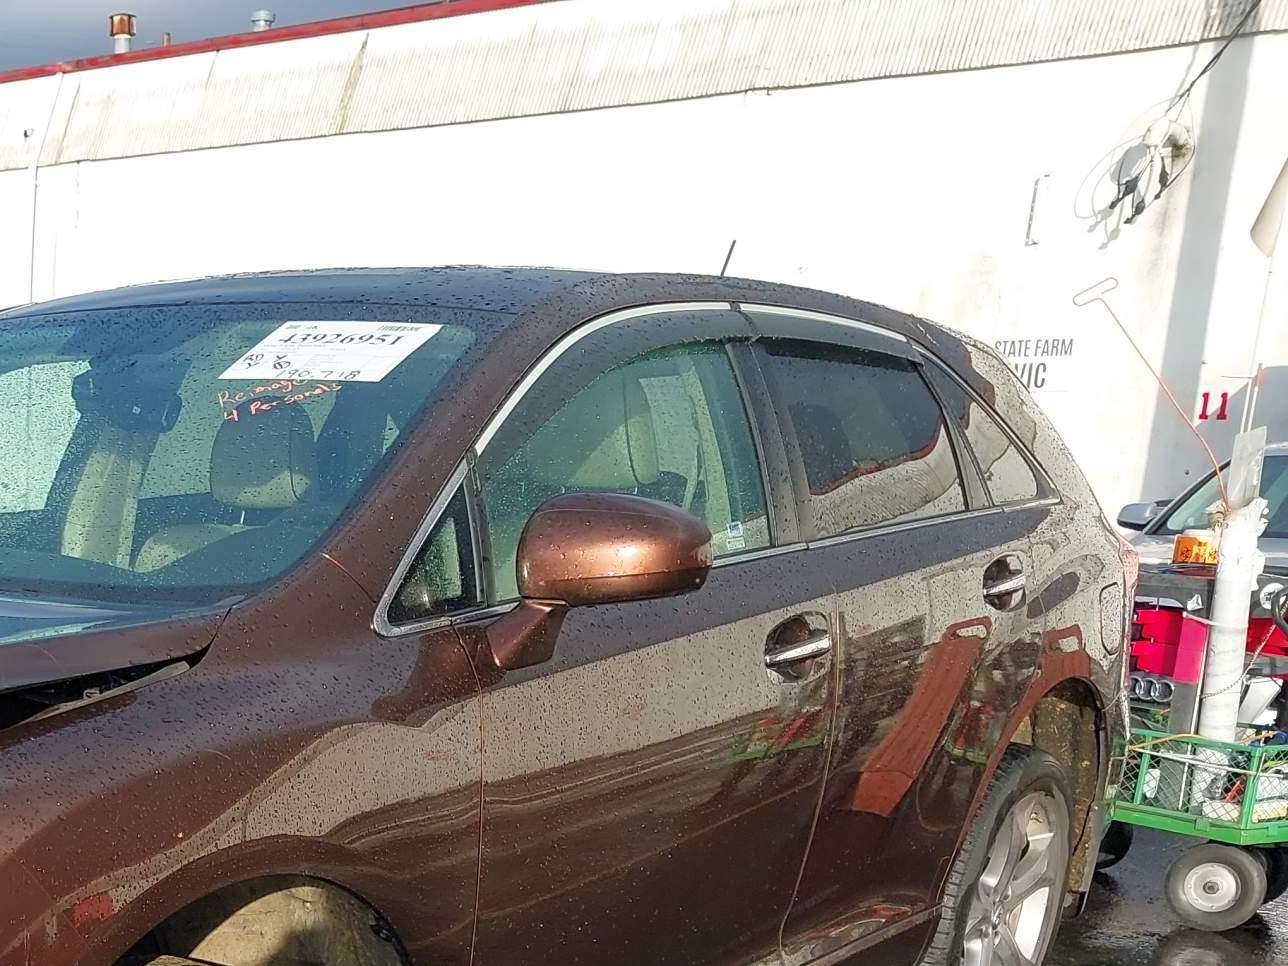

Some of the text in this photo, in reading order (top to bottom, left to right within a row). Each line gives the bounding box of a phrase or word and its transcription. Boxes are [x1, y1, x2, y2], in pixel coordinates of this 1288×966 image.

[279, 333, 405, 346] 43926951
[995, 338, 1074, 358] STATE FARM
[1014, 362, 1047, 389] VIC
[1197, 391, 1230, 421] 11
